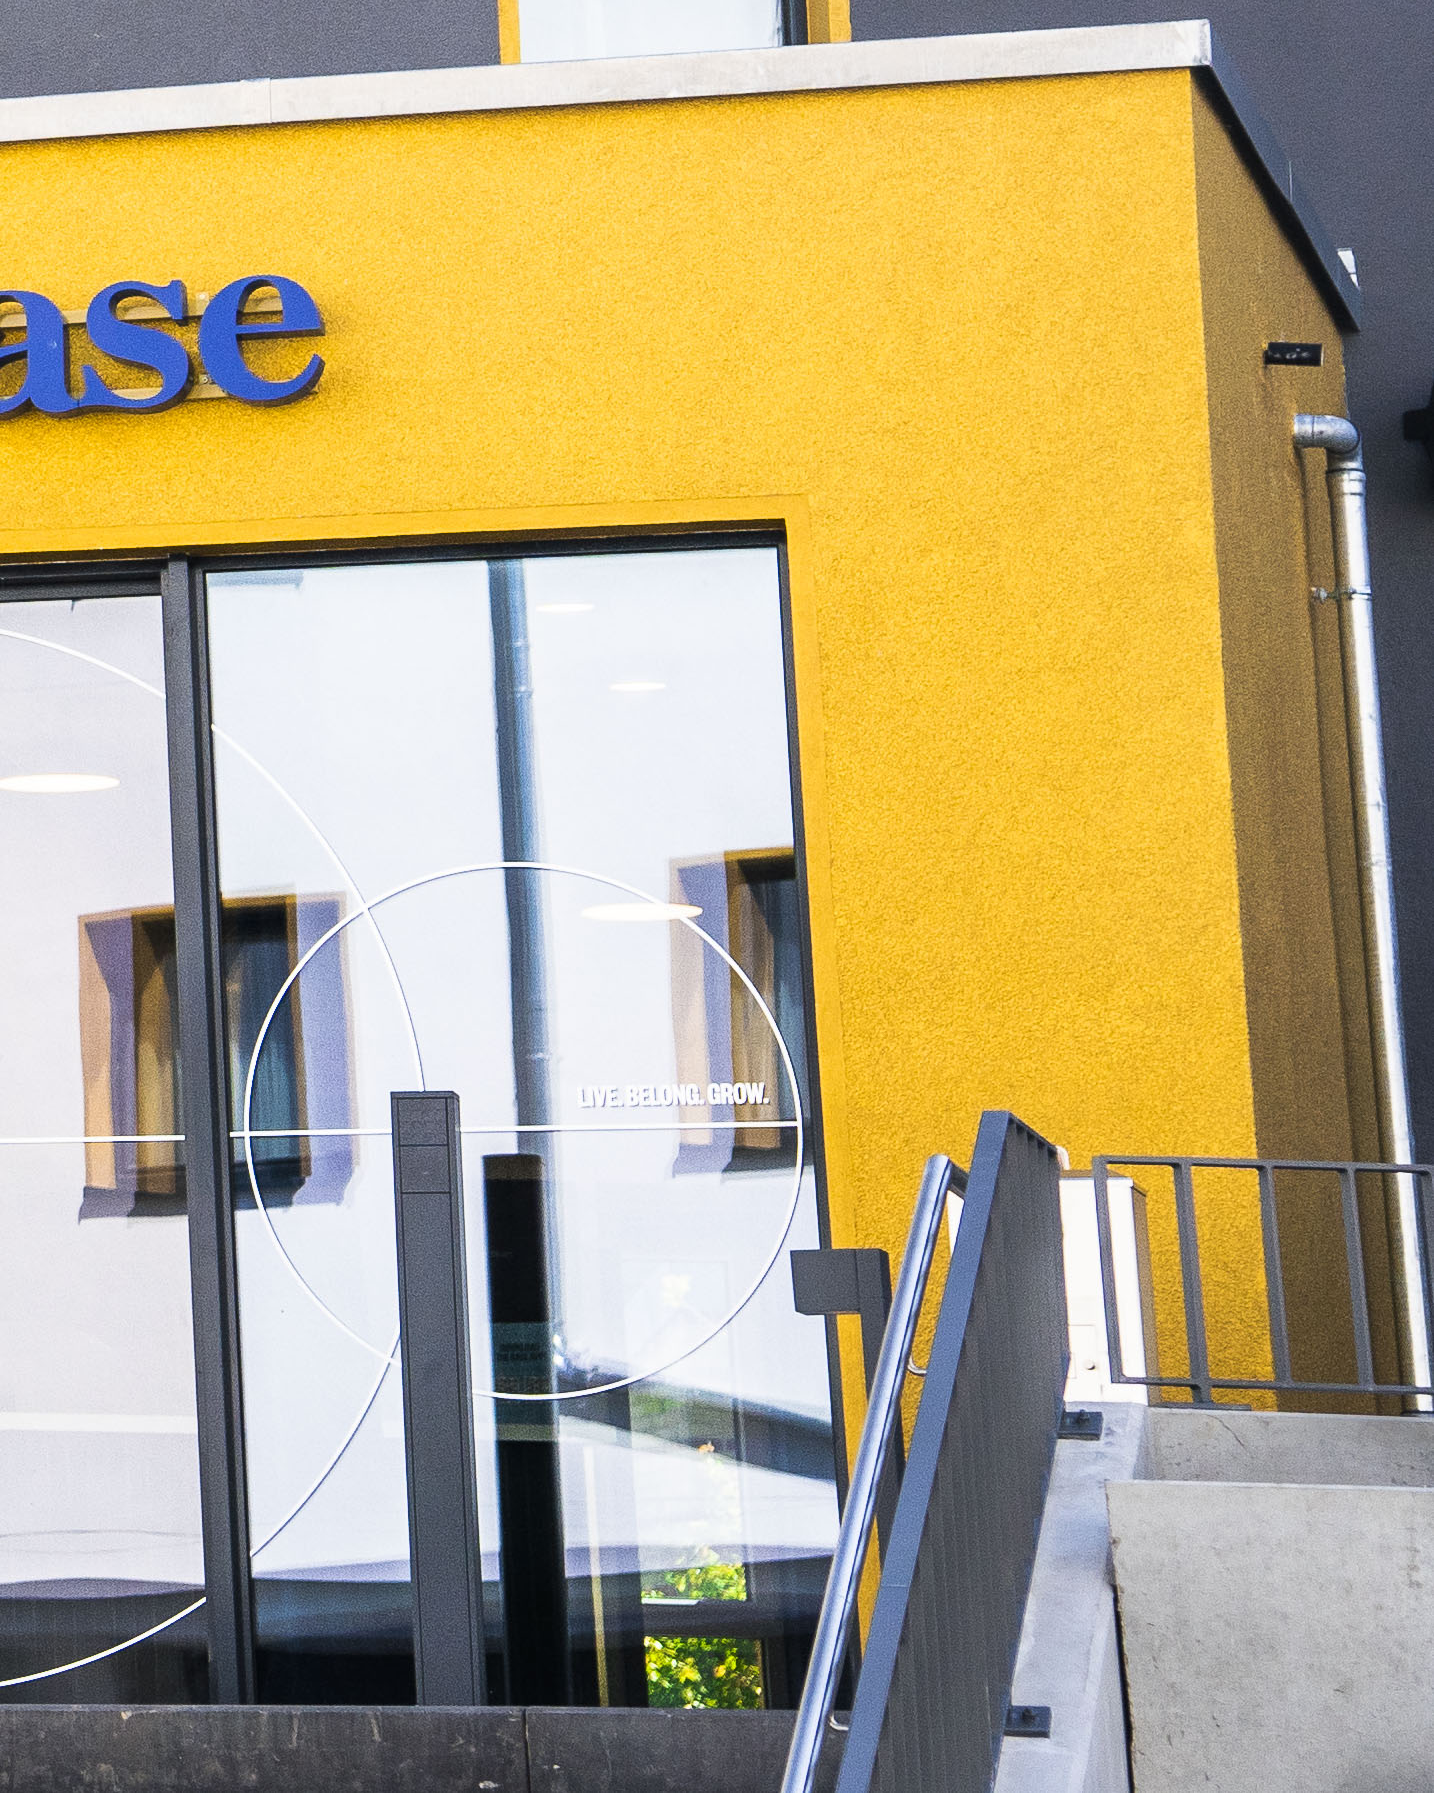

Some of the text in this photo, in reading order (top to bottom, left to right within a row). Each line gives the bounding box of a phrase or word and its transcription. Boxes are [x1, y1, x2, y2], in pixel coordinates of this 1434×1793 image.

[576, 1081, 771, 1108] LIVE. BELONG. GROW.
